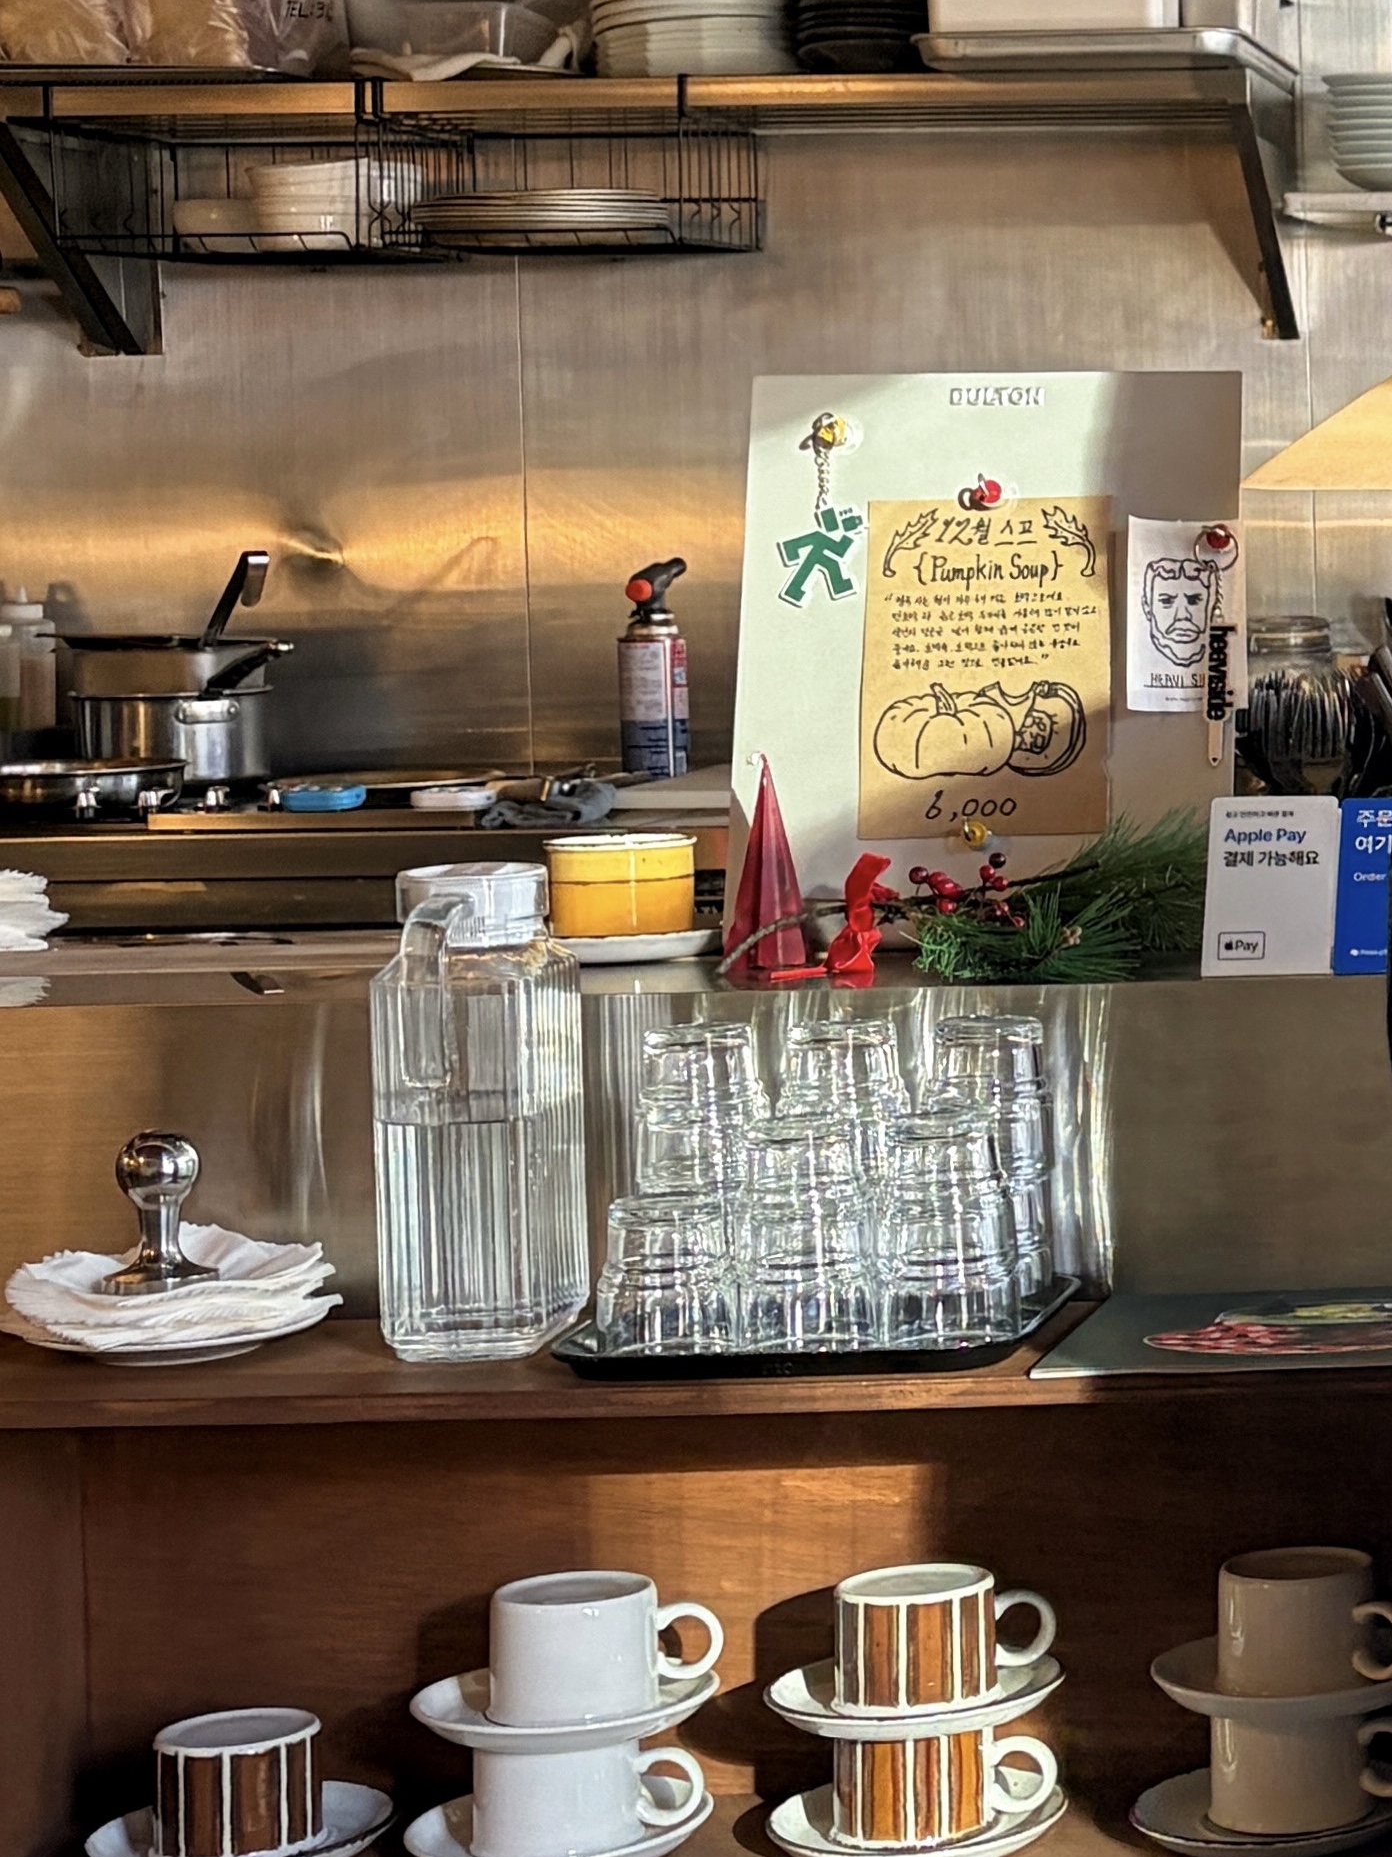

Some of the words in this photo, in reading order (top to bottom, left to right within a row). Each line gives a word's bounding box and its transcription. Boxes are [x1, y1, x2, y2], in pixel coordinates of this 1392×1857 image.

[949, 386, 1045, 407] DULTON
[1206, 625, 1238, 722] heaviside
[1224, 828, 1273, 845] Apple
[1275, 828, 1307, 844] Pay
[1223, 850, 1255, 867] 결제
[1258, 850, 1320, 867] 가능해요
[1353, 871, 1387, 882] Order
[1234, 939, 1260, 954] Pay
